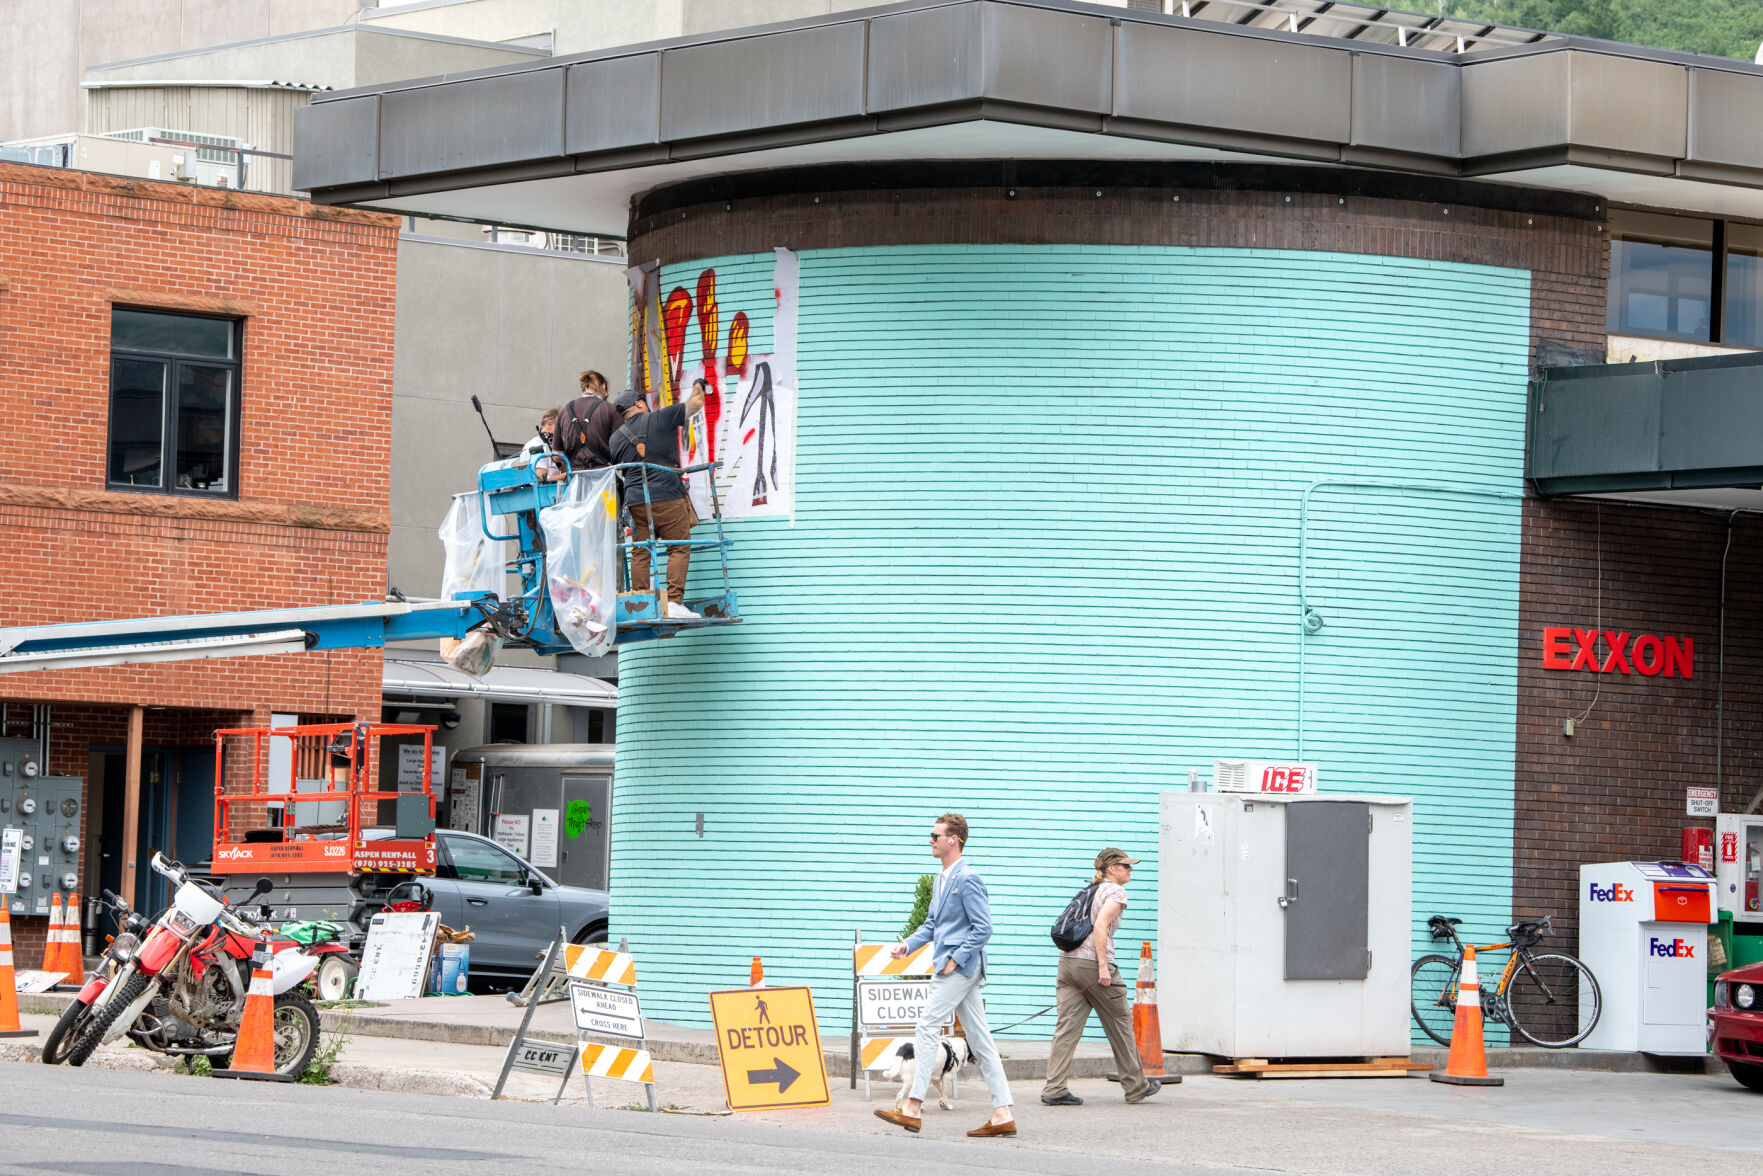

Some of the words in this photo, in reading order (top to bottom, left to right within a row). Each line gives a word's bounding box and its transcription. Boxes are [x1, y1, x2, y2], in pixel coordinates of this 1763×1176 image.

[1543, 627, 1694, 679] EXXON
[1261, 767, 1306, 792] ICE
[1688, 788, 1717, 798] EMERGENCY
[218, 846, 253, 860] SKYJACK
[324, 846, 346, 857] SJ3226
[354, 851, 380, 859] ASPEN
[381, 851, 417, 859] RENT-ALL
[426, 850, 435, 863] 3
[354, 860, 377, 868] (970)
[1590, 883, 1634, 902] FedEx
[1650, 937, 1694, 958] FedEx
[577, 989, 608, 1001] SIDEWALK
[610, 994, 633, 1005] CLOSED
[868, 987, 928, 1001] SIDEWAL
[596, 1001, 617, 1011] AHEAD
[877, 1006, 925, 1019] CLOSE
[591, 1019, 611, 1029] CROSS
[612, 1022, 628, 1031] HERE
[727, 1025, 808, 1050] DETOUR
[524, 1050, 537, 1060] CC
[538, 1051, 559, 1063] ENT
